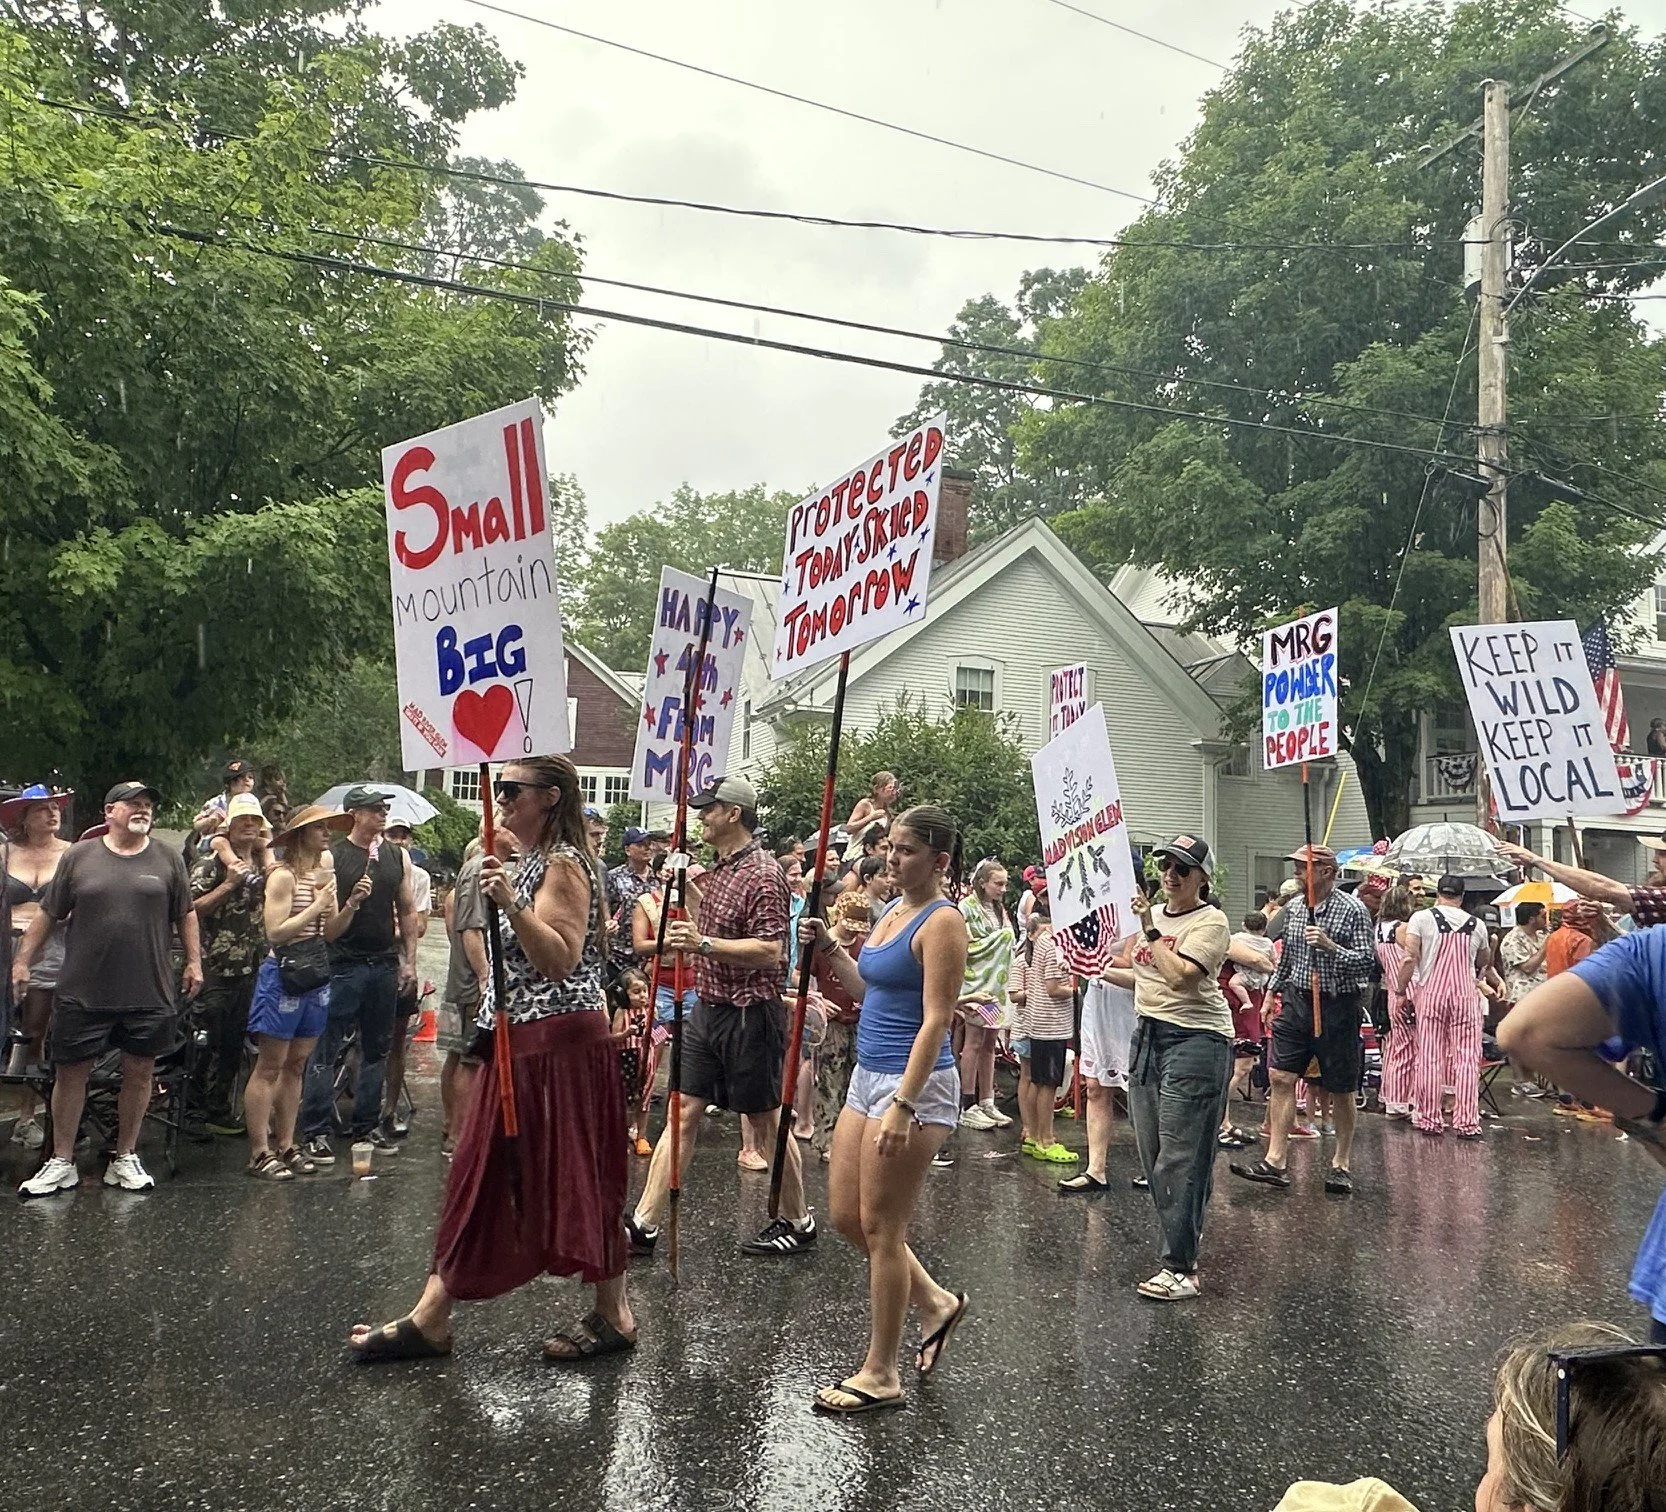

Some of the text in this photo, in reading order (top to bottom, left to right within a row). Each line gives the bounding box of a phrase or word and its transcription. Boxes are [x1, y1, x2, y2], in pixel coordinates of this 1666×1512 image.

[391, 417, 545, 570] Small
[795, 523, 859, 596] TODAY
[660, 587, 740, 649] HAPPY
[1270, 615, 1333, 668] MRG
[436, 624, 527, 696] BIG
[1265, 653, 1336, 708] POWDER
[1459, 629, 1573, 687] KEEP IT
[1267, 698, 1323, 732] TO THE
[1485, 677, 1580, 717] WILD
[1266, 721, 1330, 766] PEOPLE
[1481, 719, 1593, 763] KEEP IT
[644, 746, 715, 803] MRG
[1494, 757, 1614, 811] LOCAL
